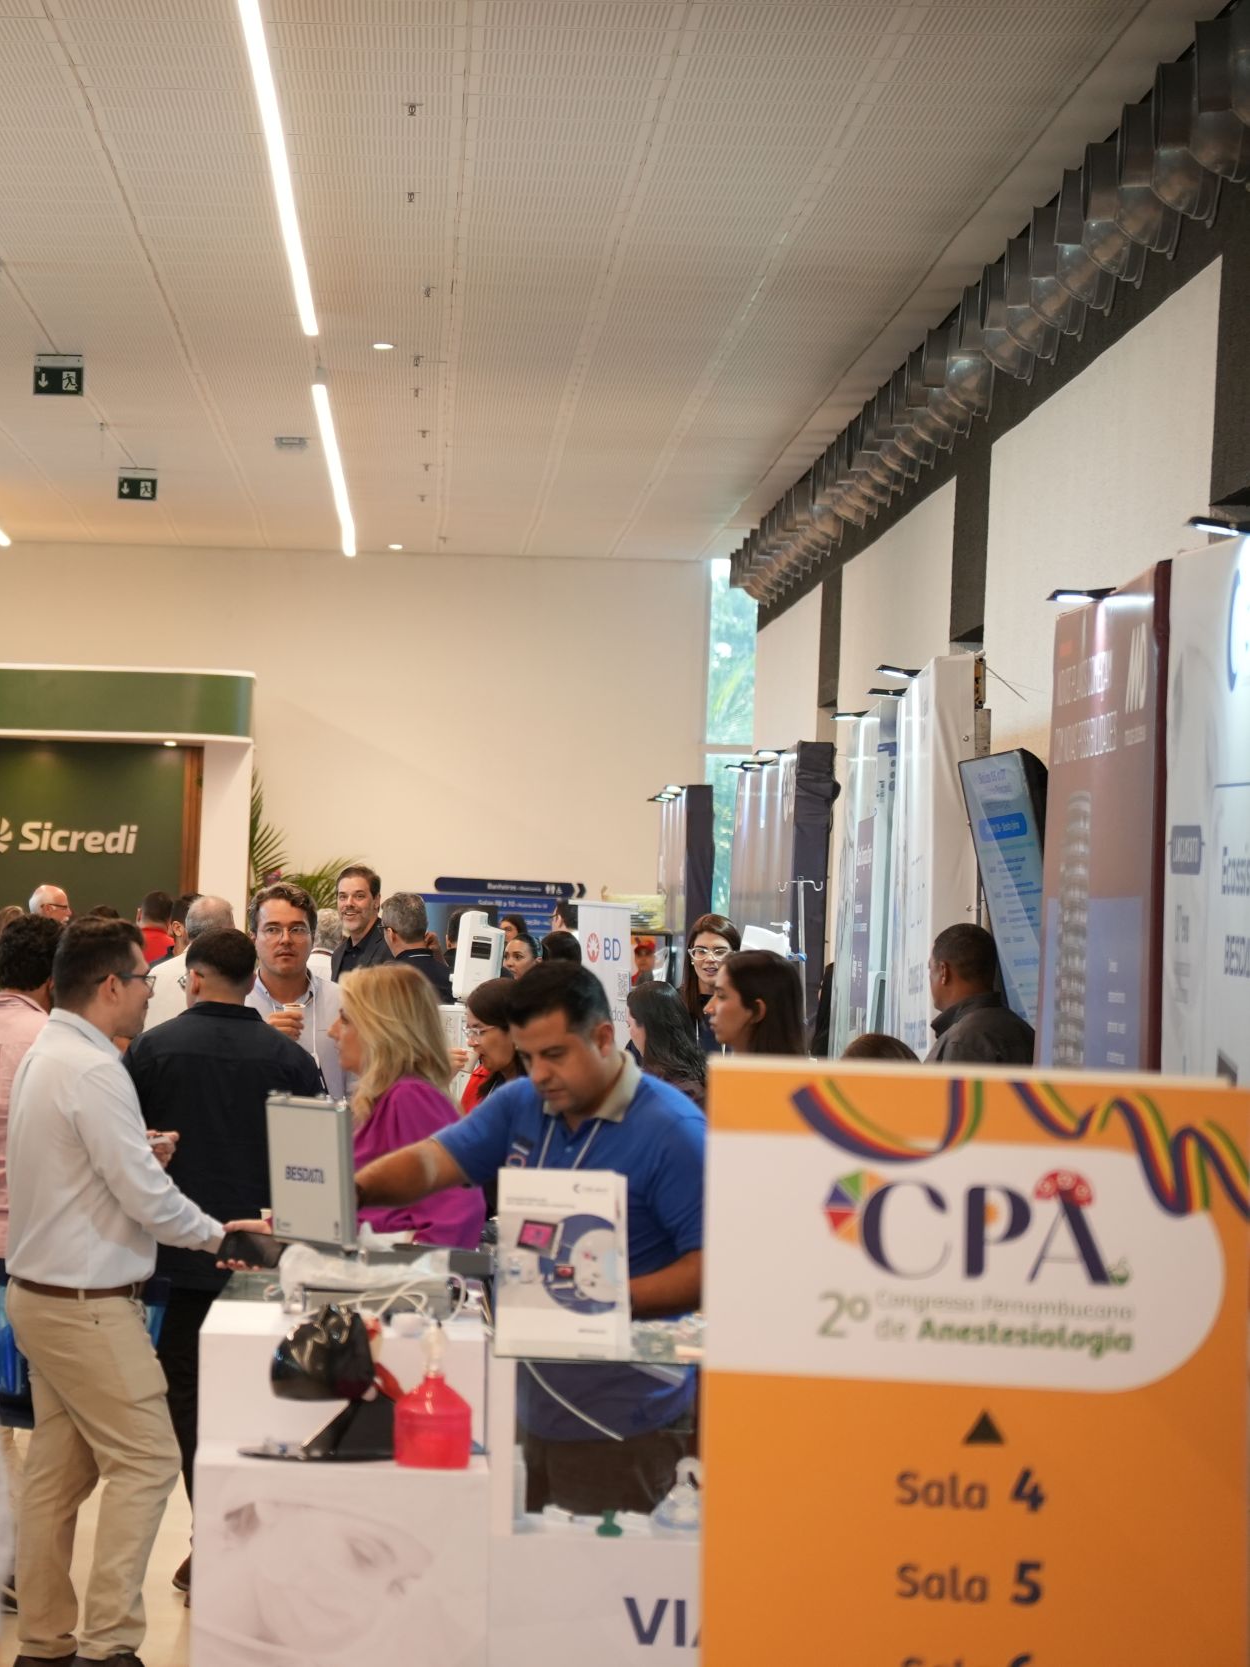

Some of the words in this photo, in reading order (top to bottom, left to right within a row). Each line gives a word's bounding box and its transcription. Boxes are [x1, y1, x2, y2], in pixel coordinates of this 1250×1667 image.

[18, 821, 138, 855] Sicredi
[604, 938, 621, 962] BD
[860, 1177, 1113, 1287] CPA
[980, 1295, 1134, 1321] Pernambucano
[875, 1313, 909, 1340] de
[917, 1317, 1134, 1358] Anestesiologia
[895, 1470, 988, 1511] Sala
[1009, 1467, 1046, 1514] 4
[895, 1563, 989, 1604] Sala
[1010, 1560, 1045, 1606] 5
[623, 1597, 701, 1647] VI
